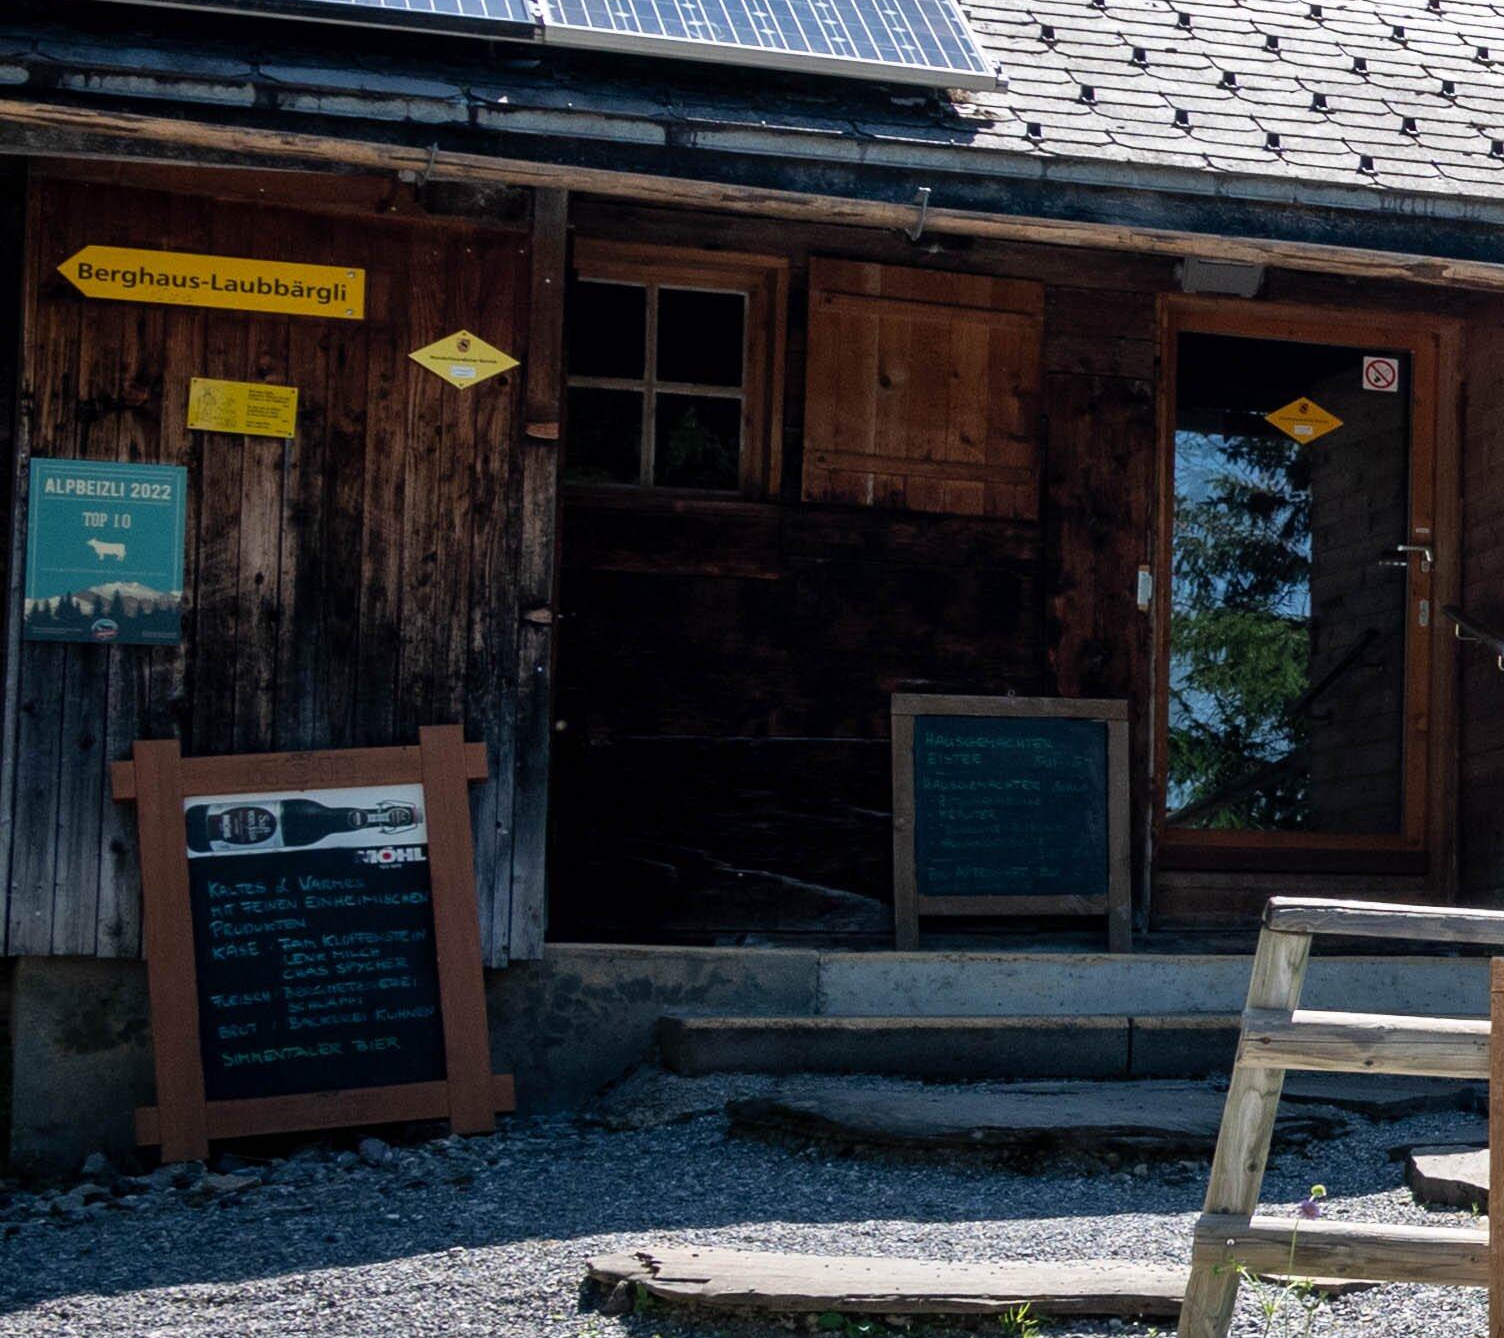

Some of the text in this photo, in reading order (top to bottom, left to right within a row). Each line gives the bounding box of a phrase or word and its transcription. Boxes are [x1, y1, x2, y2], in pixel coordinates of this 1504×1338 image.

[77, 262, 347, 305] Berghaus-Laubbärgli
[44, 477, 172, 500] ALPBEIZLI 2022
[82, 512, 132, 529] TOP 10
[219, 1036, 402, 1068] SIMMENTALER BIER
